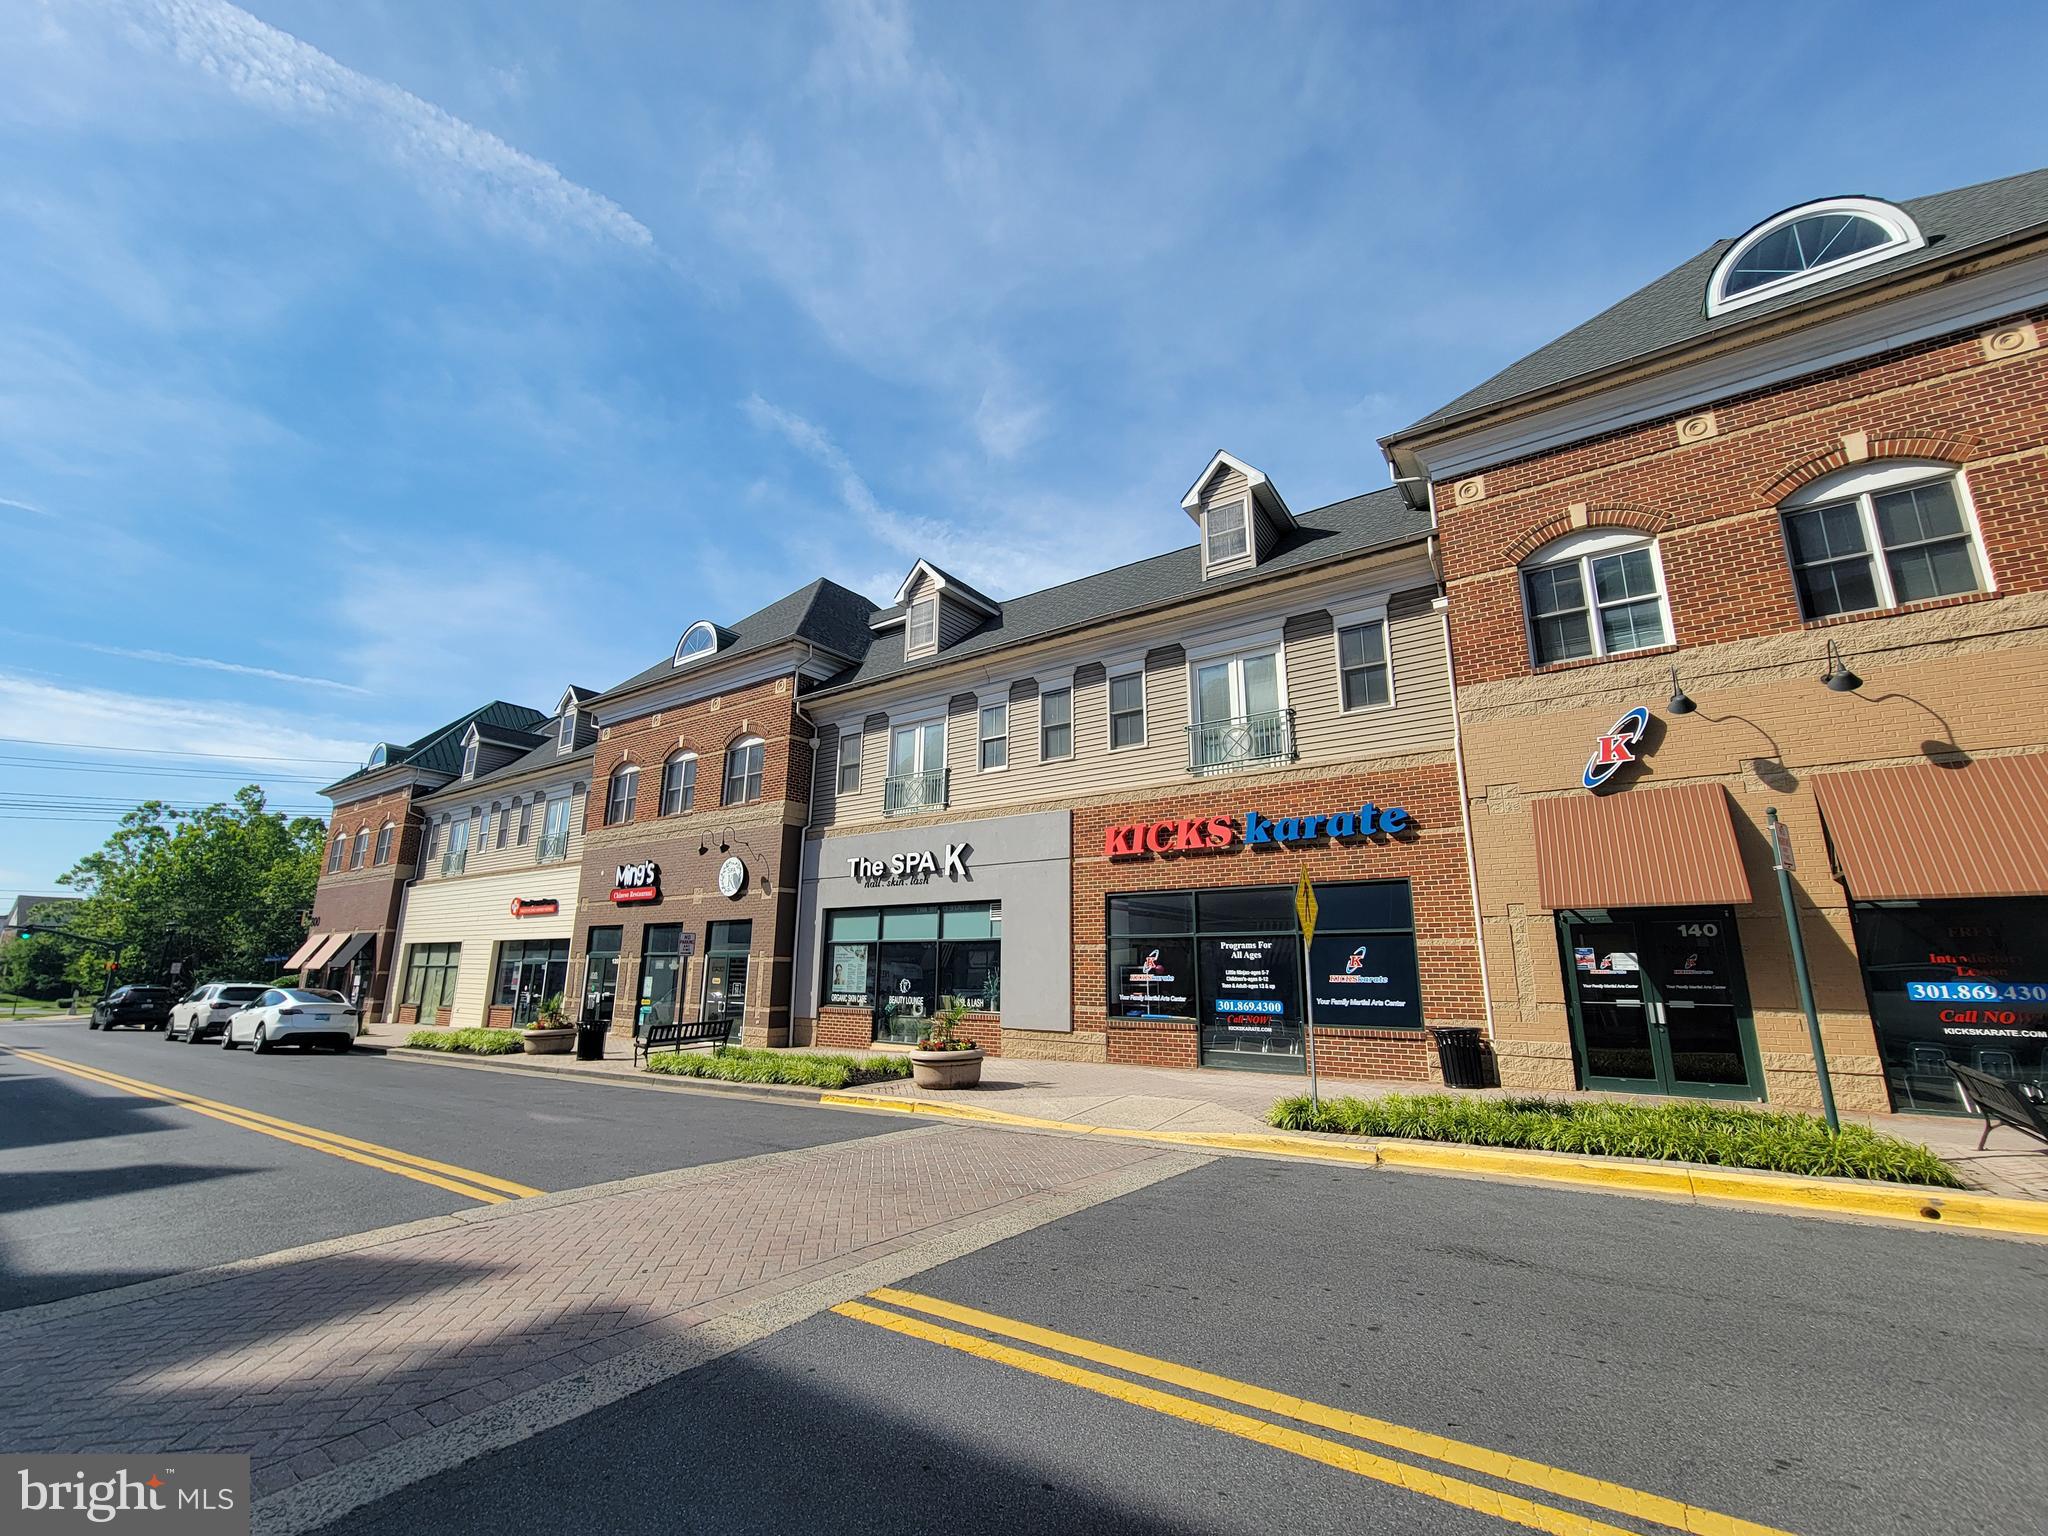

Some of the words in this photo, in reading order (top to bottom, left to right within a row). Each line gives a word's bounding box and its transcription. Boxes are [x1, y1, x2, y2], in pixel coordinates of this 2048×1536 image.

[1597, 733, 1635, 764] K
[1103, 815, 1233, 856] KICKS
[1243, 801, 1408, 845] karate
[847, 857, 884, 877] The
[891, 851, 936, 875] SPA
[944, 843, 967, 876] K
[615, 860, 655, 887] Ming's
[864, 878, 881, 888] nail
[887, 877, 904, 887] skin
[910, 877, 929, 885] lash
[1677, 924, 1718, 937] 140
[1220, 941, 1257, 951] Programs
[1258, 941, 1273, 949] For
[1231, 951, 1243, 959] All
[1244, 951, 1262, 960] Ages
[831, 993, 847, 1002] ORGANIC
[848, 994, 857, 1002] SKIN
[857, 994, 868, 1003] CARE
[1913, 984, 2048, 1001] 301.869.430
[889, 995, 905, 1005] BEAUTY
[905, 996, 924, 1005] LOUNGE
[971, 998, 984, 1007] LASH
[1331, 998, 1349, 1006] Family
[1218, 1001, 1281, 1012] 301.869.4300
[1227, 1014, 1244, 1023] Call
[1940, 1010, 1978, 1023] Call
[1944, 1028, 2048, 1038] KICKSKARATE.COM
